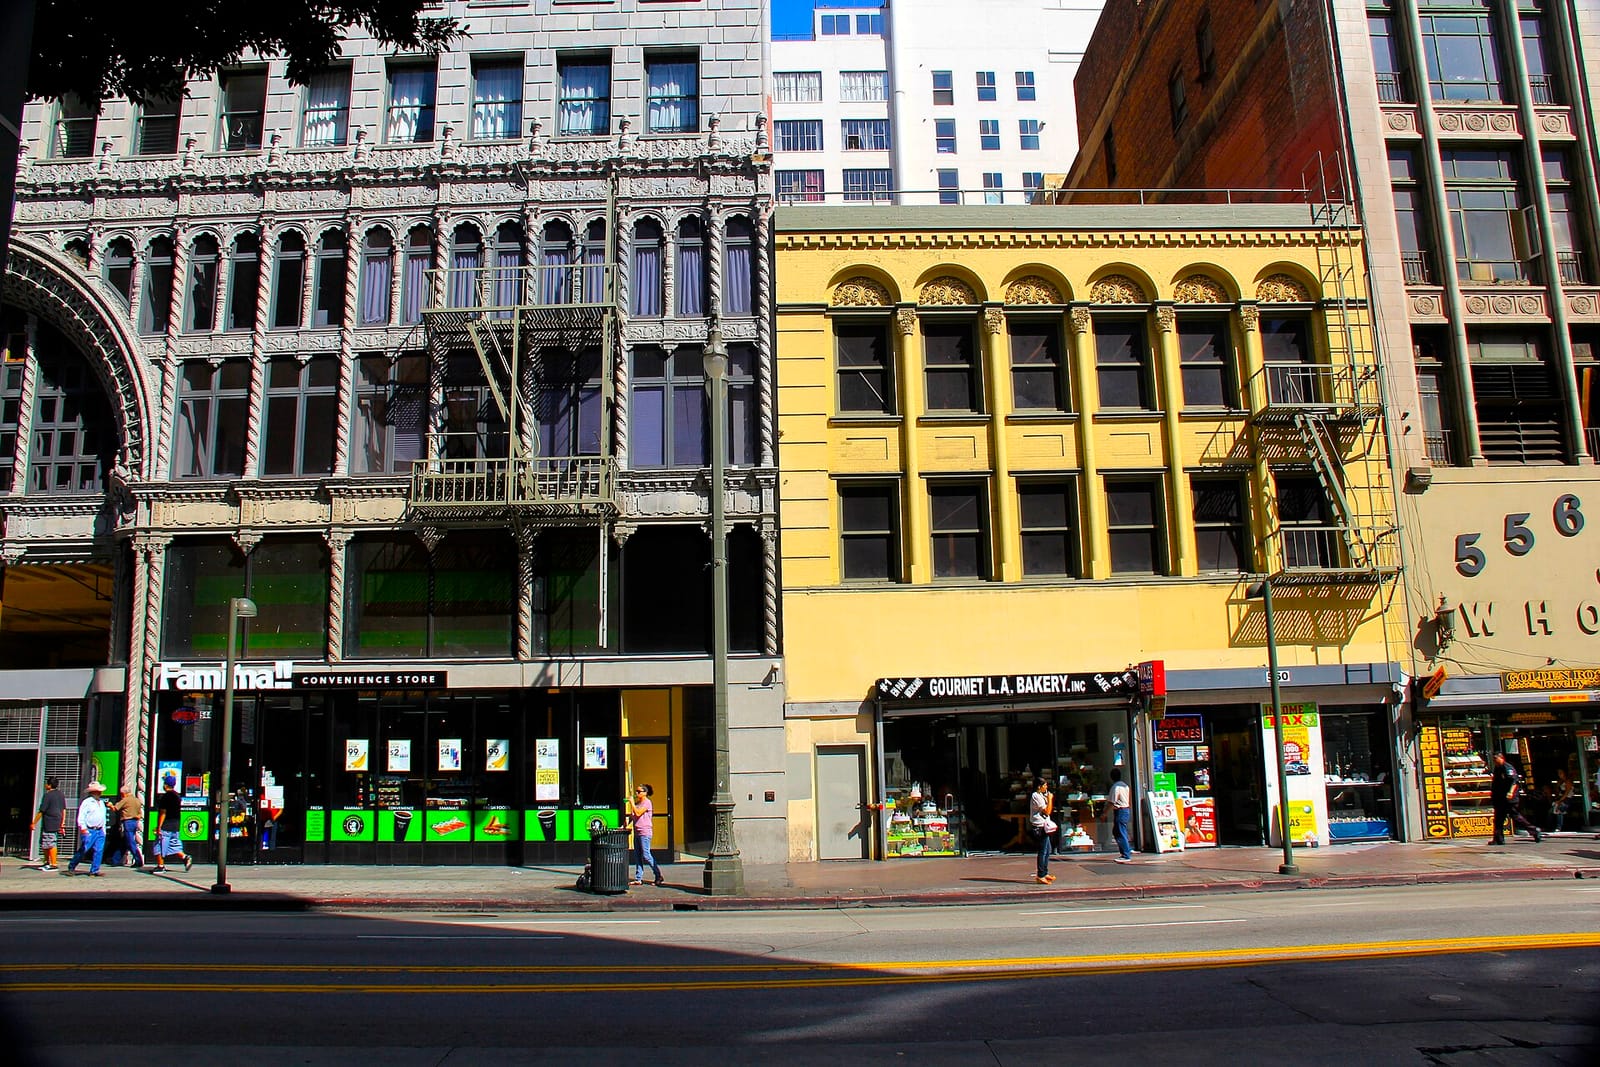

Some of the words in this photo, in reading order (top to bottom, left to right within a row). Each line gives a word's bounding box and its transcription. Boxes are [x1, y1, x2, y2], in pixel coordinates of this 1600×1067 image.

[1455, 494, 1585, 577] 556
[302, 676, 390, 685] CONVENIENCE
[396, 675, 436, 684] STORE
[1111, 676, 1122, 686] OF
[1507, 671, 1571, 683] GOLDEN
[930, 678, 984, 696] GOURMET
[988, 676, 1014, 694] L.A.
[1093, 673, 1111, 692] CAKE
[1539, 680, 1584, 690] Jewelry
[1265, 704, 1304, 714] INOME
[1158, 730, 1169, 739] DE
[1172, 728, 1201, 738] VIAJES
[538, 748, 547, 756] $2
